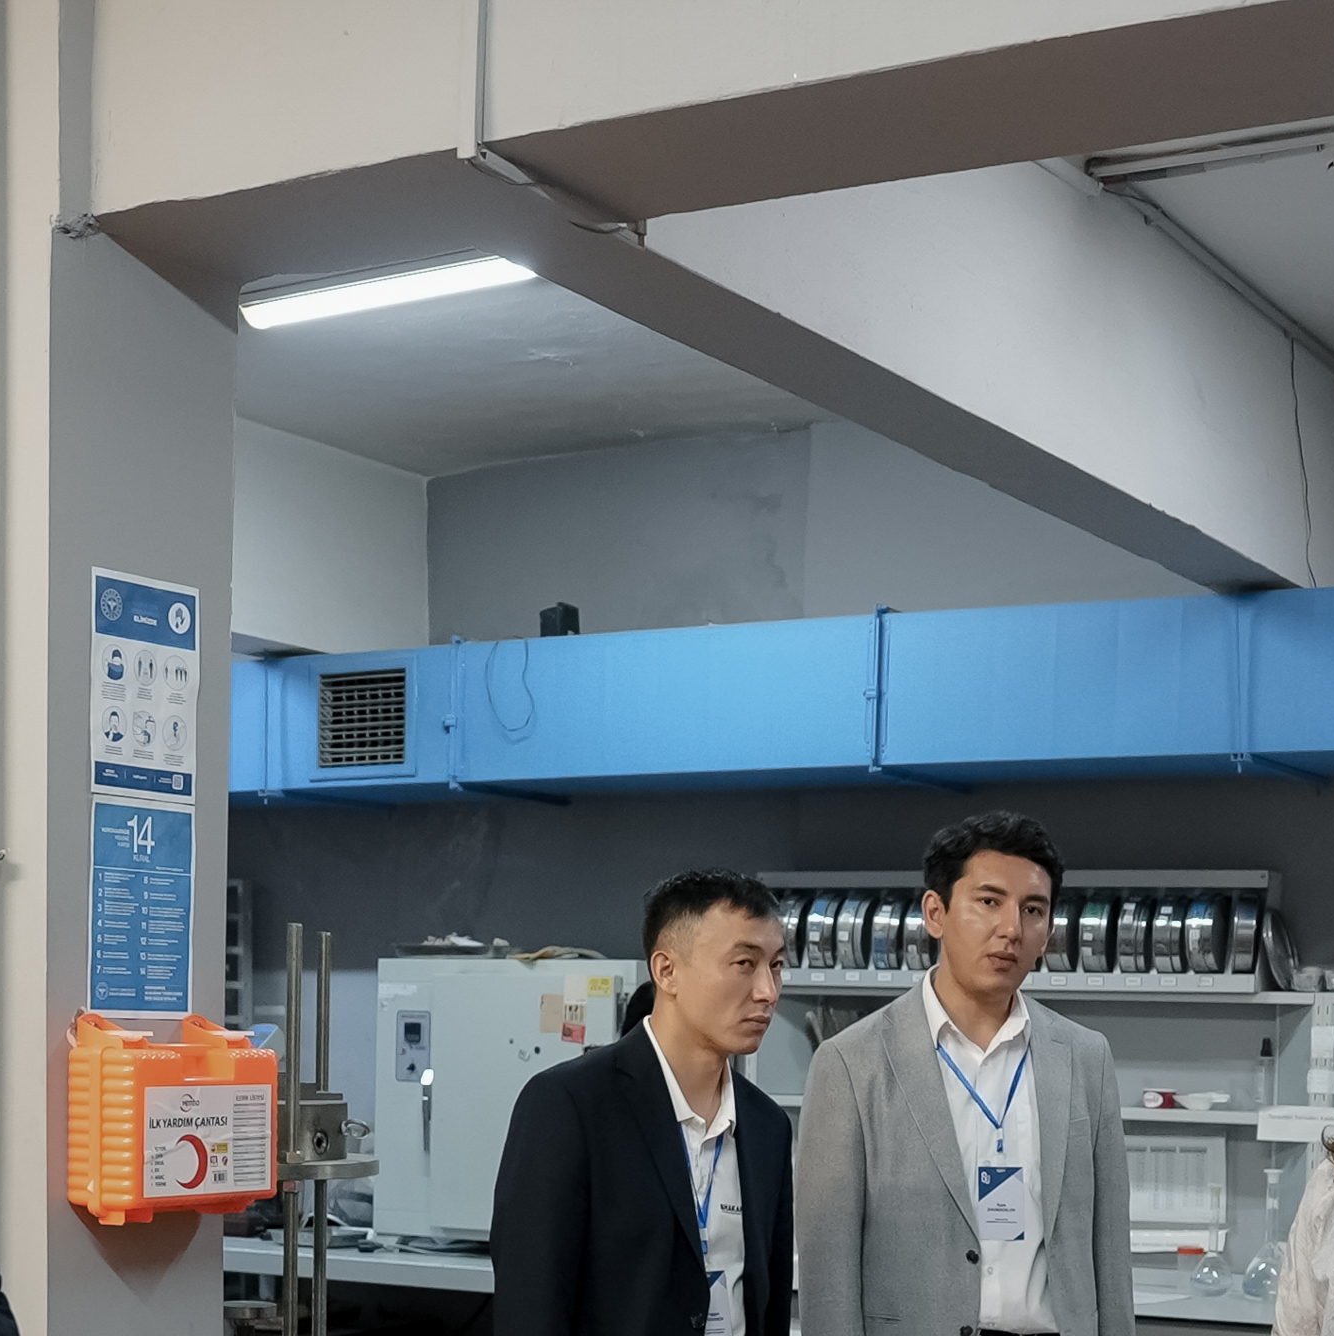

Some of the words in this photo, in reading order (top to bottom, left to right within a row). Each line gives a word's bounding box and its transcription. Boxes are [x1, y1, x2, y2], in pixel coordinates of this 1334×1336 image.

[127, 815, 155, 855] 14
[149, 1117, 162, 1129] İLK
[163, 1118, 193, 1129] YARDIM
[195, 1116, 228, 1130] ÇANTASI
